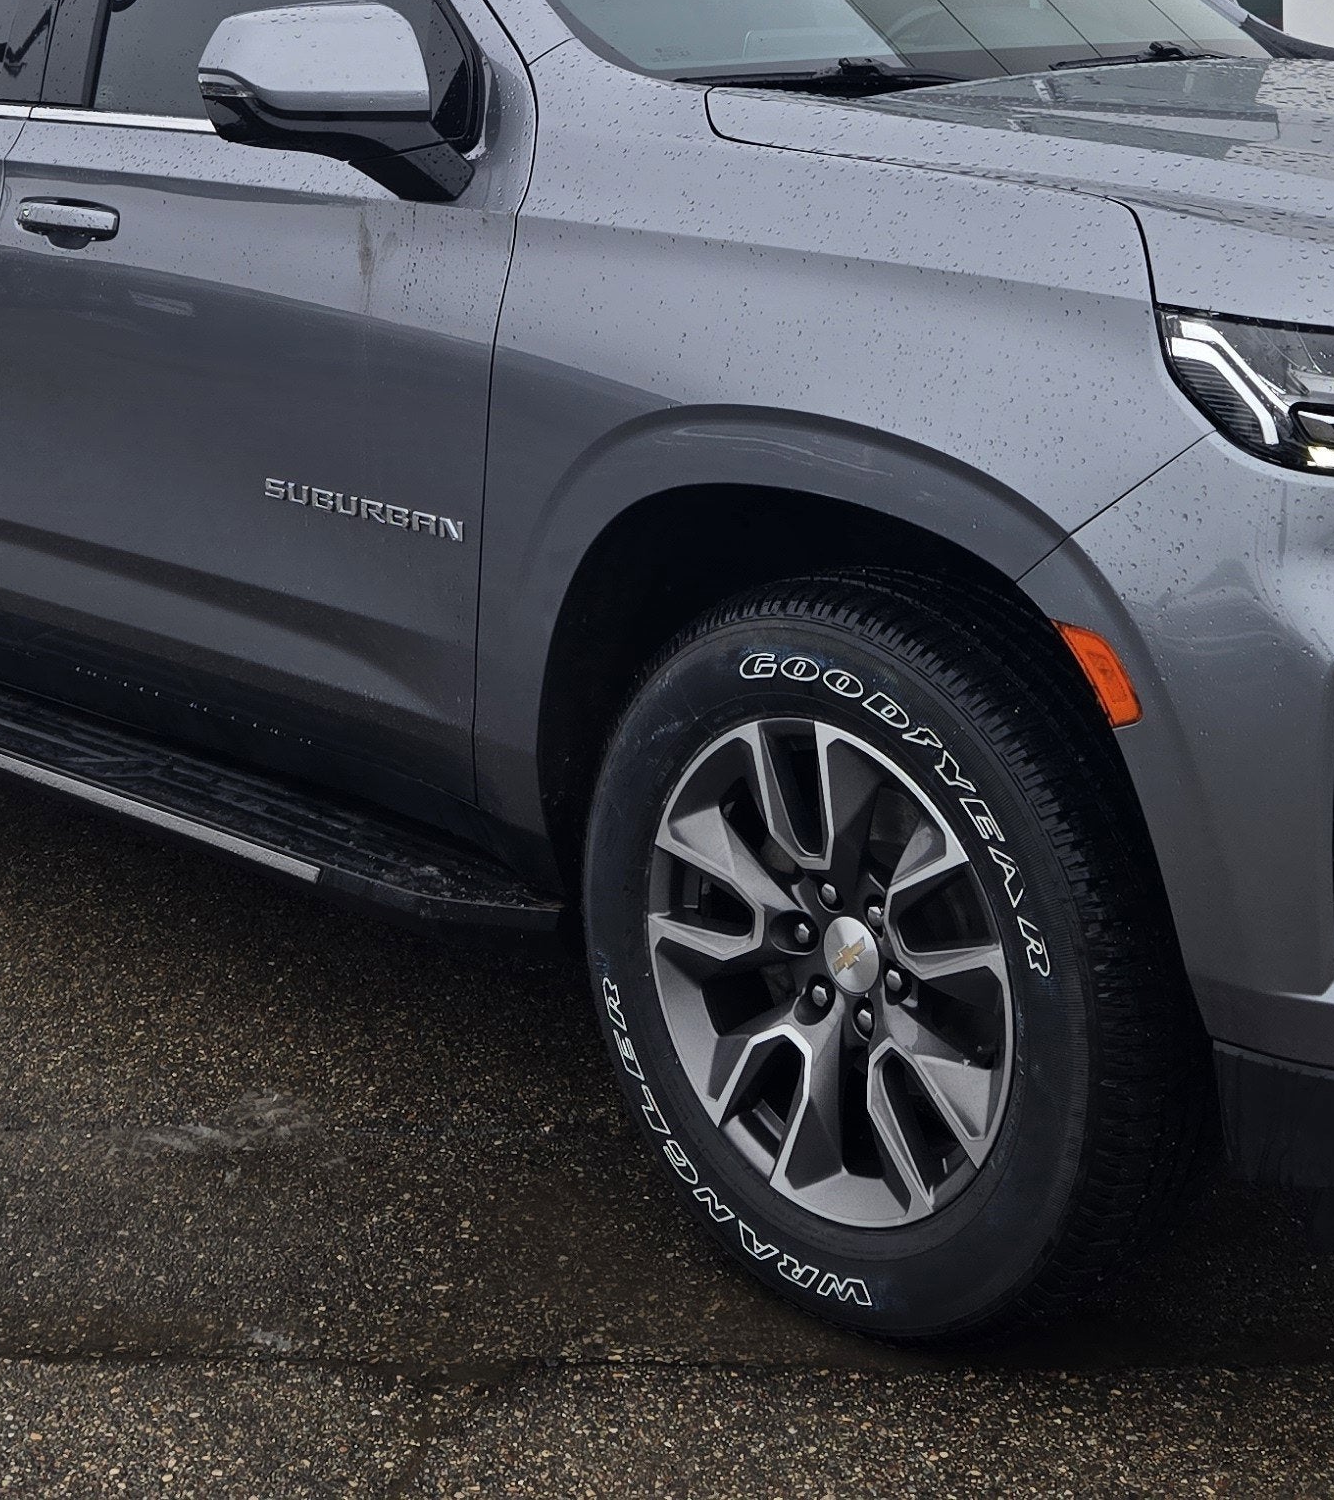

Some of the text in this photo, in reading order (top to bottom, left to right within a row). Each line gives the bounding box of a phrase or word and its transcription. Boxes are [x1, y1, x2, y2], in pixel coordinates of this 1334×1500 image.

[264, 477, 464, 543] SUBURBAN
[739, 652, 1051, 977] GOODYEAR
[602, 977, 872, 1307] WRANGLER
